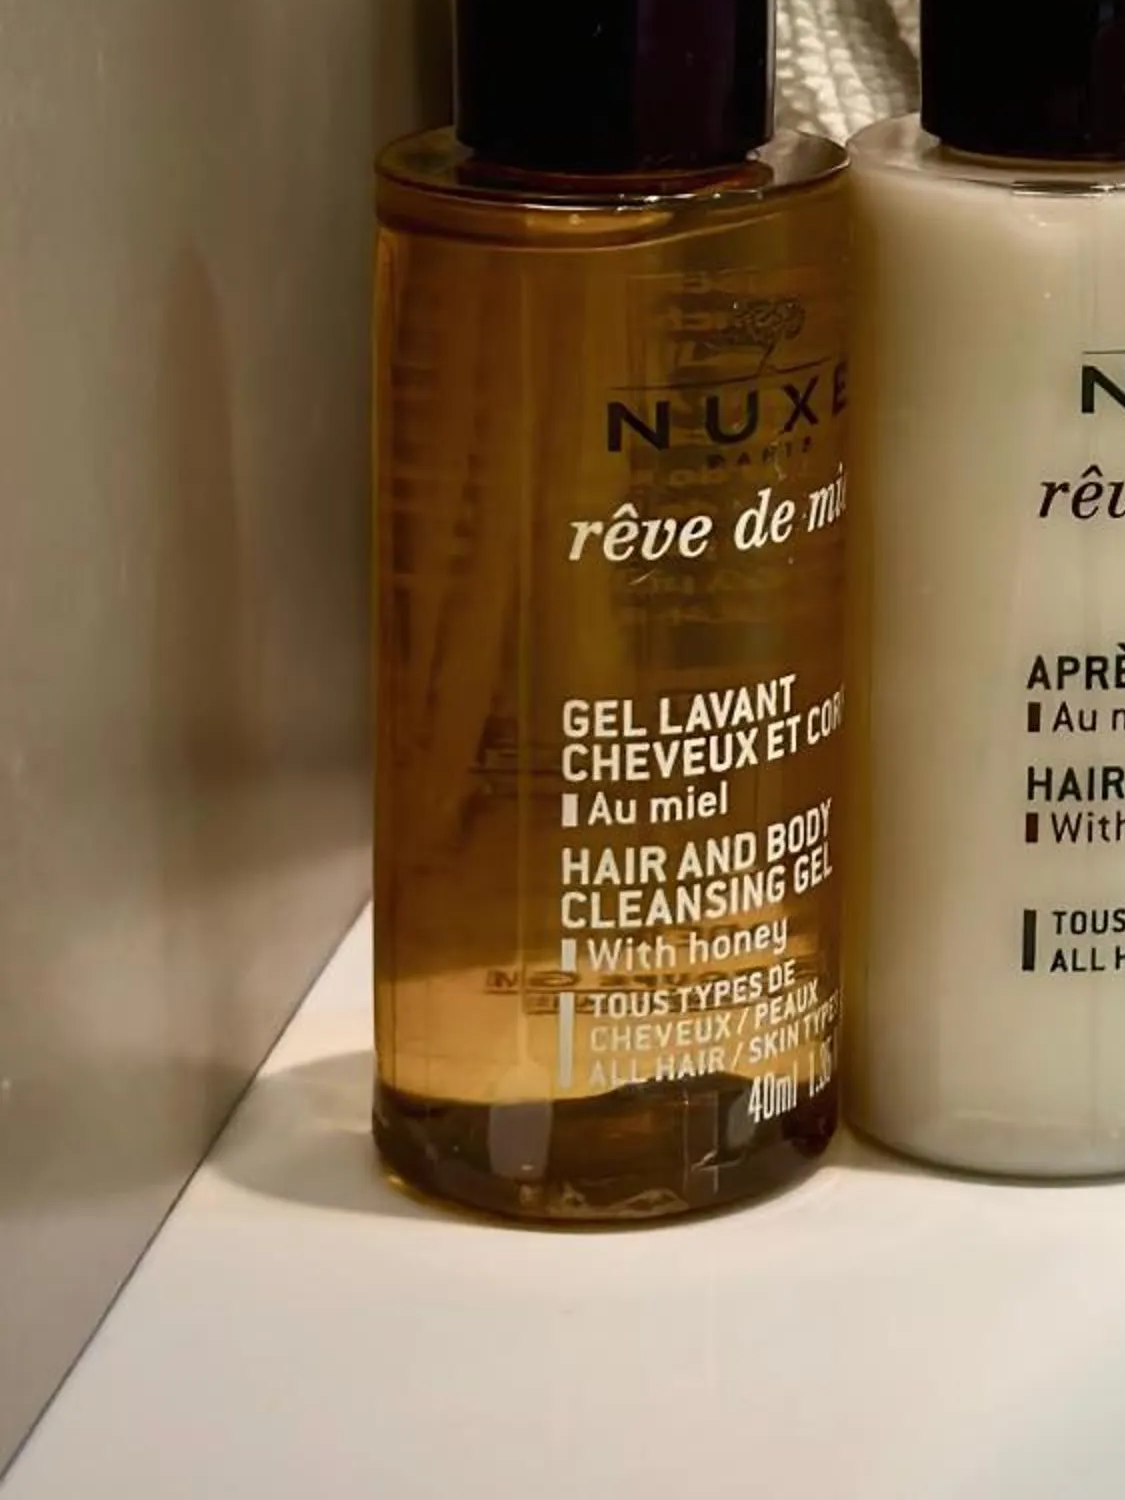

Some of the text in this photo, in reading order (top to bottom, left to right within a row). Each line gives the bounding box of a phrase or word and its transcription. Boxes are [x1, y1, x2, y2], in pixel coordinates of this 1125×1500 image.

[607, 360, 847, 452] NUXE
[568, 502, 713, 562] rêve
[733, 487, 795, 551] de
[562, 673, 796, 739] GEL LAVANT
[1052, 701, 1097, 732] Au
[561, 728, 758, 782] CHEVEUX
[767, 713, 801, 761] ET
[588, 780, 728, 826] Au miel
[1027, 765, 1125, 802] HAIR
[562, 796, 832, 886] HAIR AND BODY
[561, 841, 832, 929] CLEANSING GEL
[588, 917, 787, 973] With honey
[1050, 947, 1105, 972] ALL
[588, 990, 669, 1019] TOUS
[677, 971, 762, 1014] TYPES
[768, 959, 796, 994] DE
[590, 1014, 730, 1051] CHEVEUX
[754, 979, 818, 1029] PEAUX
[588, 1058, 647, 1089] ALL
[655, 1046, 726, 1083] HAIR
[749, 1023, 799, 1063] SKIN
[748, 1060, 797, 1124] 40ml
